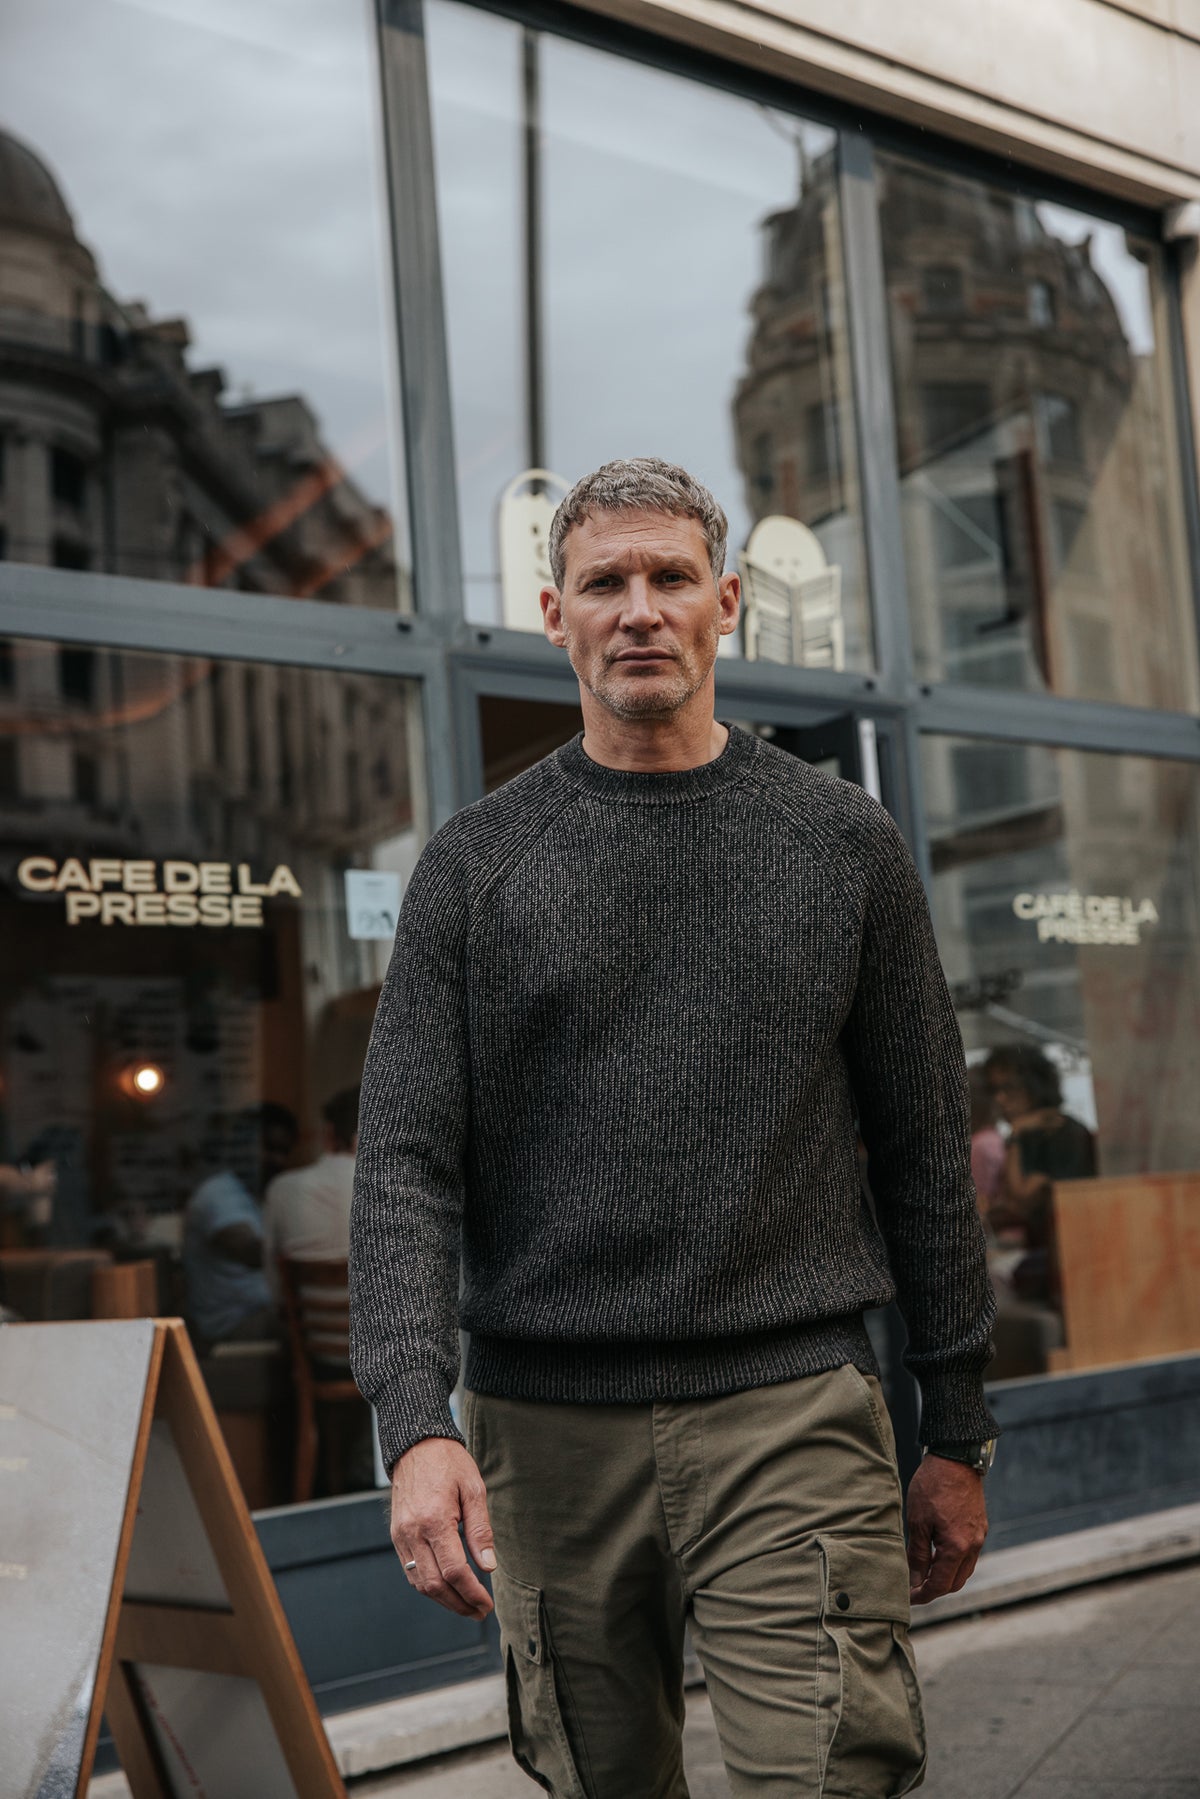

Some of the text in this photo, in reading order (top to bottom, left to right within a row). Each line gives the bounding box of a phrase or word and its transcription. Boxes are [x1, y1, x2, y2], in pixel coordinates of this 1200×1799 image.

[17, 856, 302, 897] CAFE DE LA
[65, 891, 264, 928] PRESSE
